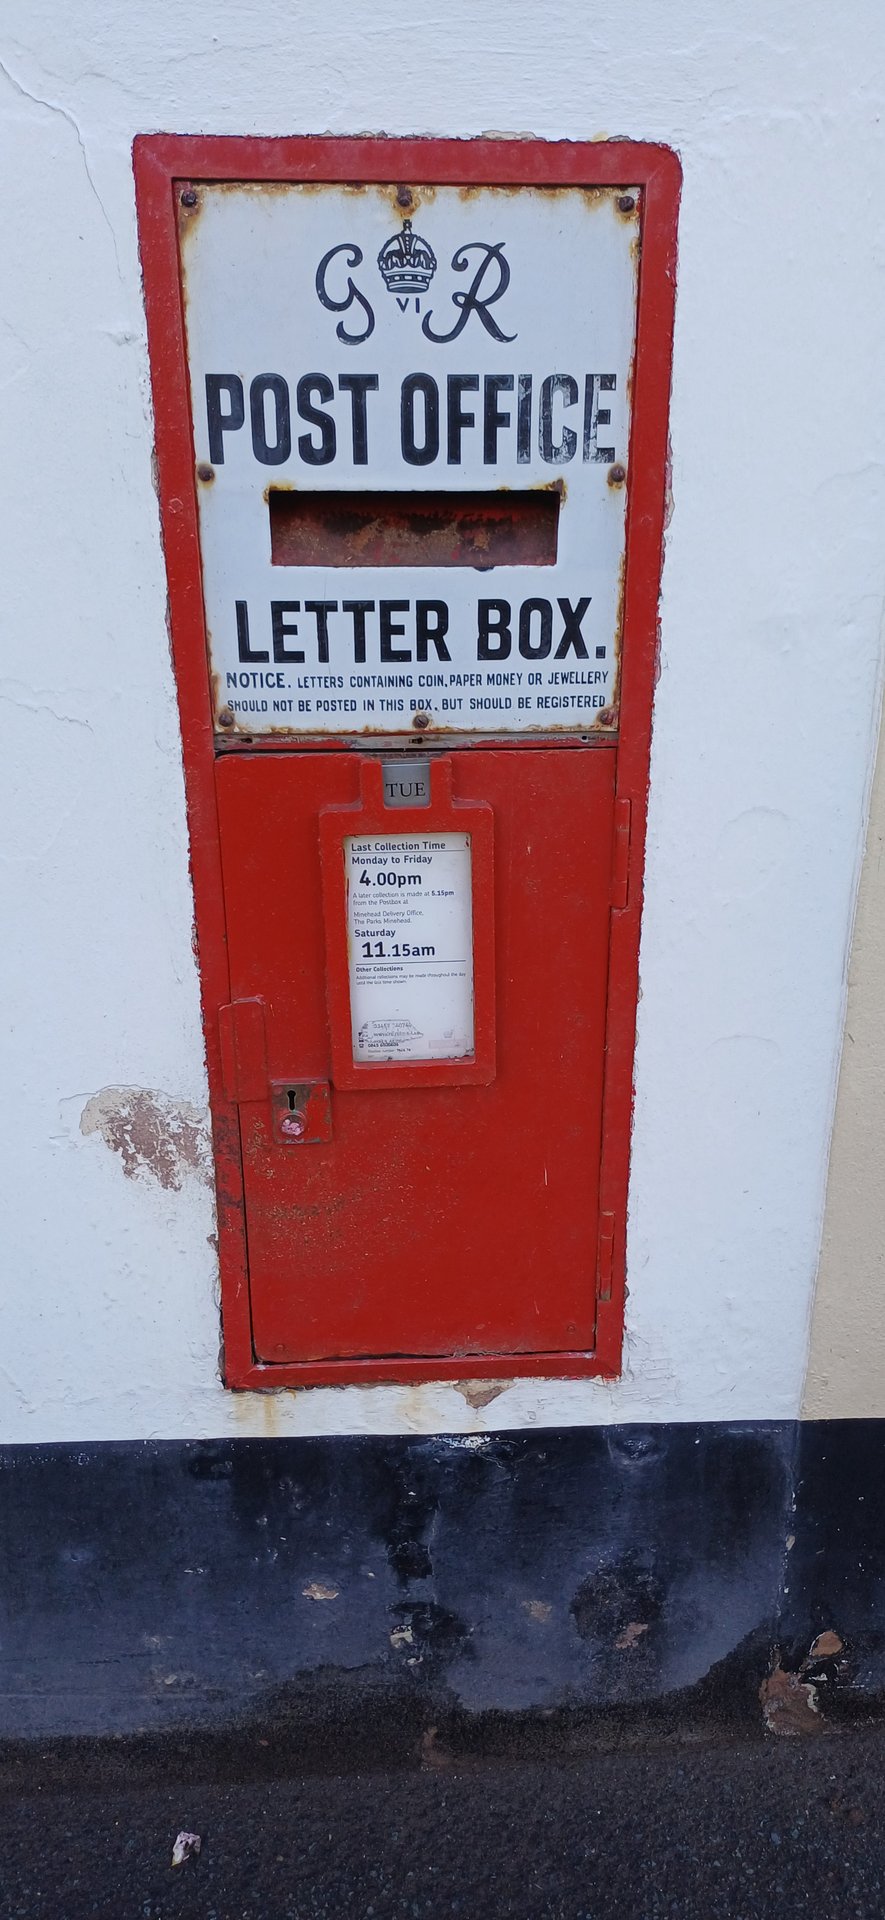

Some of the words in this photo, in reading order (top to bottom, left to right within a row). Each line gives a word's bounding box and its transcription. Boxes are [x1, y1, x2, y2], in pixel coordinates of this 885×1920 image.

[315, 243, 375, 346] G
[422, 242, 518, 344] R
[396, 297, 420, 313] VI
[204, 372, 379, 466] POST
[400, 372, 617, 466] OFFICE
[235, 599, 452, 663] LETTER
[477, 597, 606, 661] BOX.
[226, 672, 291, 689] NOTICE.
[298, 676, 344, 689] LETTERS
[350, 675, 413, 688] CONTAINING
[450, 673, 482, 686] PAPER
[486, 672, 523, 686] MONEY
[528, 672, 543, 685] OR
[548, 671, 609, 685] JEWELLERY
[227, 699, 268, 712] SHOULD
[273, 699, 293, 712] NOT
[298, 699, 311, 712] BE
[316, 699, 357, 712] POSTED
[363, 699, 375, 711] IN
[379, 699, 404, 711] THIS
[442, 698, 463, 710] BUT
[469, 697, 511, 710] SHOULD
[518, 696, 531, 709] BE
[537, 695, 606, 709] REGISTERED
[386, 782, 425, 797] TUE
[351, 843, 372, 852] Last
[374, 841, 420, 851] Collection
[422, 841, 446, 850] Time
[351, 856, 388, 866] Monday
[391, 856, 400, 864] to
[403, 855, 432, 865] Friday
[359, 869, 422, 888] 4.00pm
[382, 910, 405, 918] Delivery
[354, 929, 396, 938] Saturday
[361, 941, 435, 958] 11.15am
